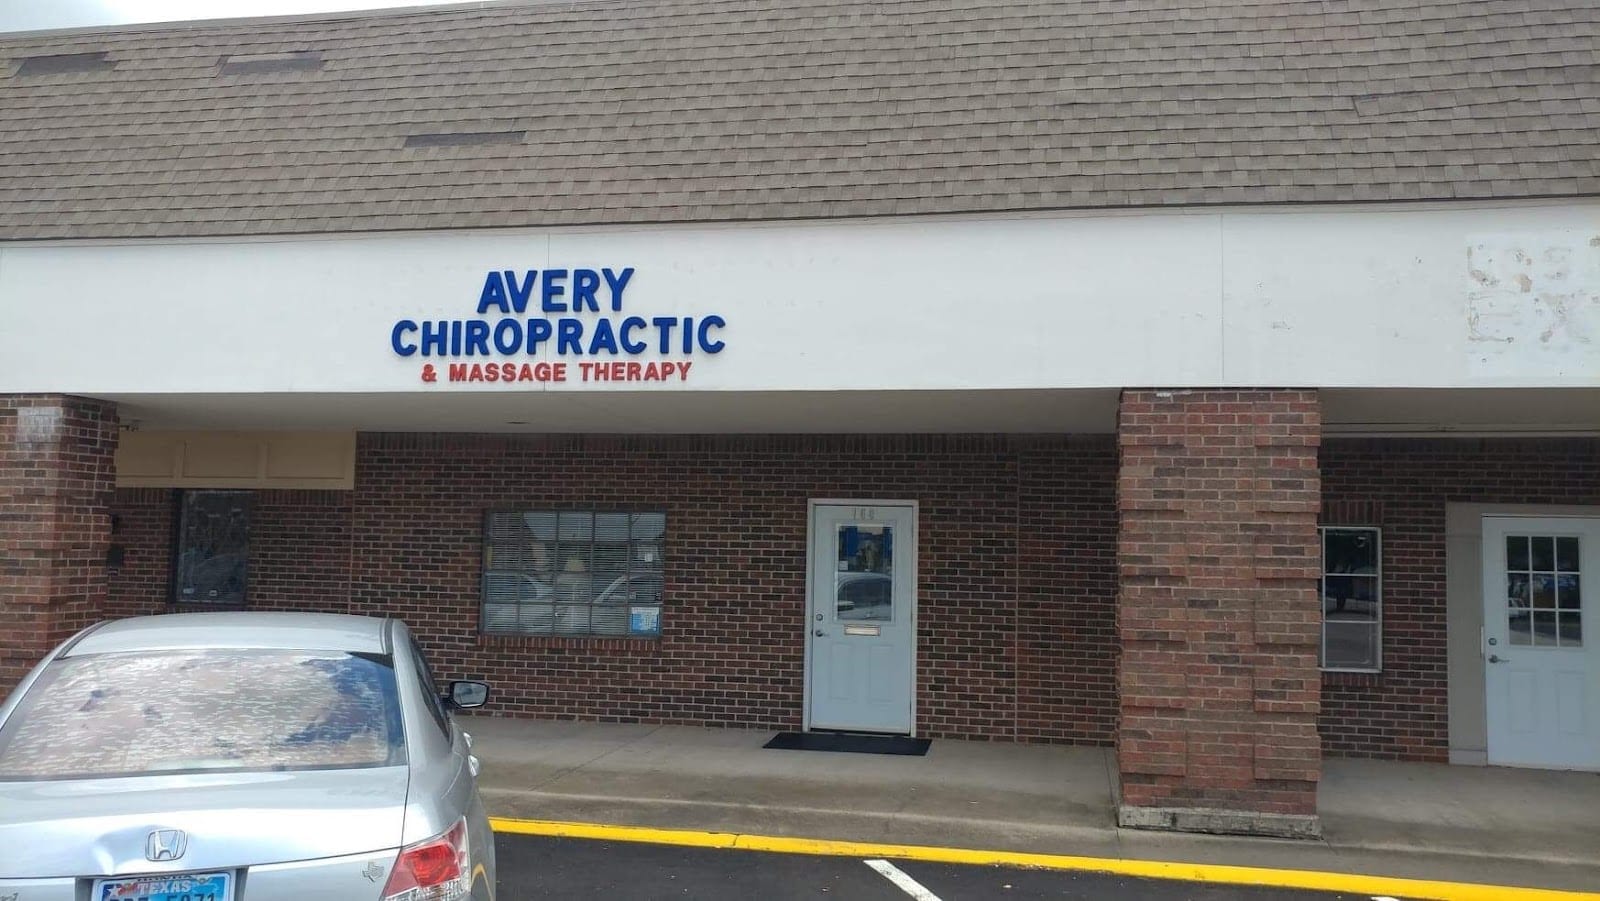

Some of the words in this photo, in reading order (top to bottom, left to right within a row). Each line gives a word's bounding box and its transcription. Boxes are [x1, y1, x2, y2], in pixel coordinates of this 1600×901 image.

[476, 267, 634, 314] AVERY
[391, 315, 726, 357] CHIROPRACTIC
[421, 364, 437, 383] &
[449, 363, 566, 382] MASSAGE
[580, 361, 693, 381] THERAPY
[138, 880, 193, 895] TEXAS
